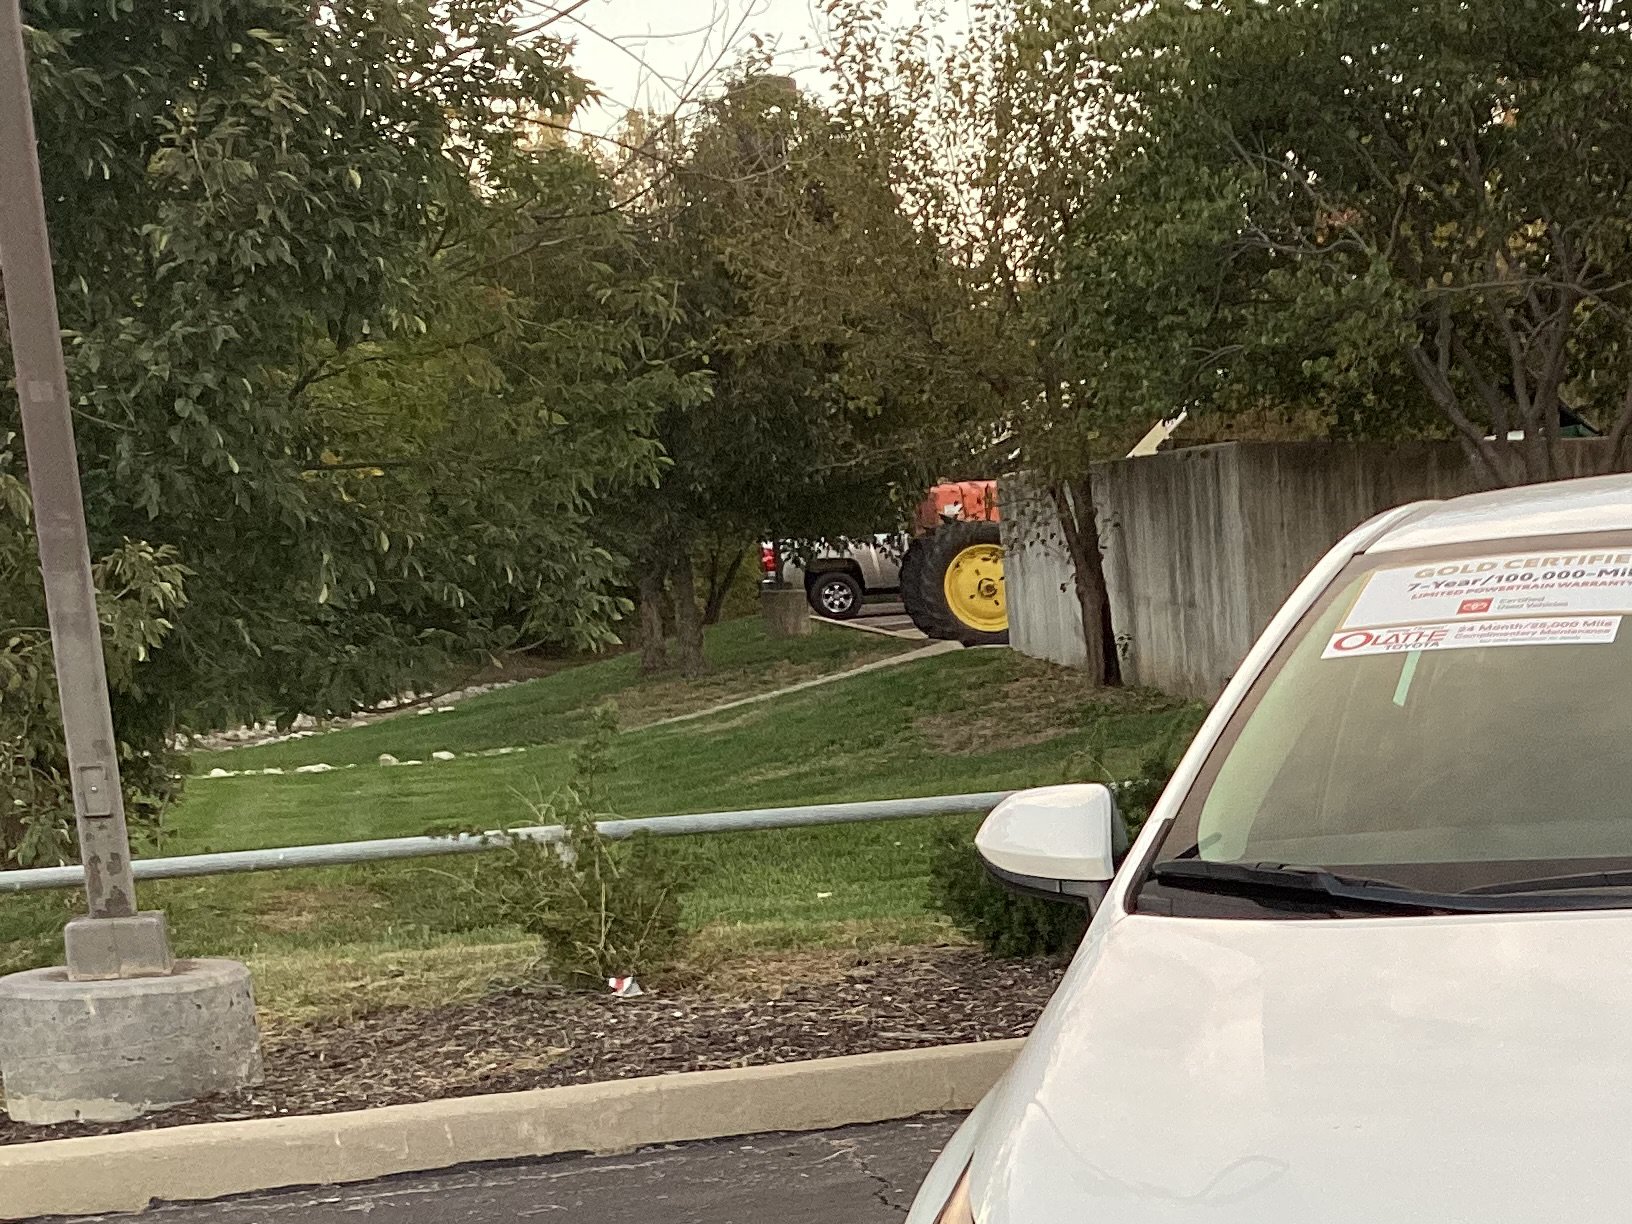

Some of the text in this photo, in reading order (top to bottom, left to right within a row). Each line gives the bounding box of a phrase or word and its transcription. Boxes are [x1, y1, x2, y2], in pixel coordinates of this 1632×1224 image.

[1414, 562, 1498, 578] GOLD
[1410, 589, 1464, 600] LIMITED
[1465, 582, 1555, 595] POWERTRAIN
[1333, 630, 1449, 651] OLATHE
[1385, 641, 1440, 651] TOYOTA
